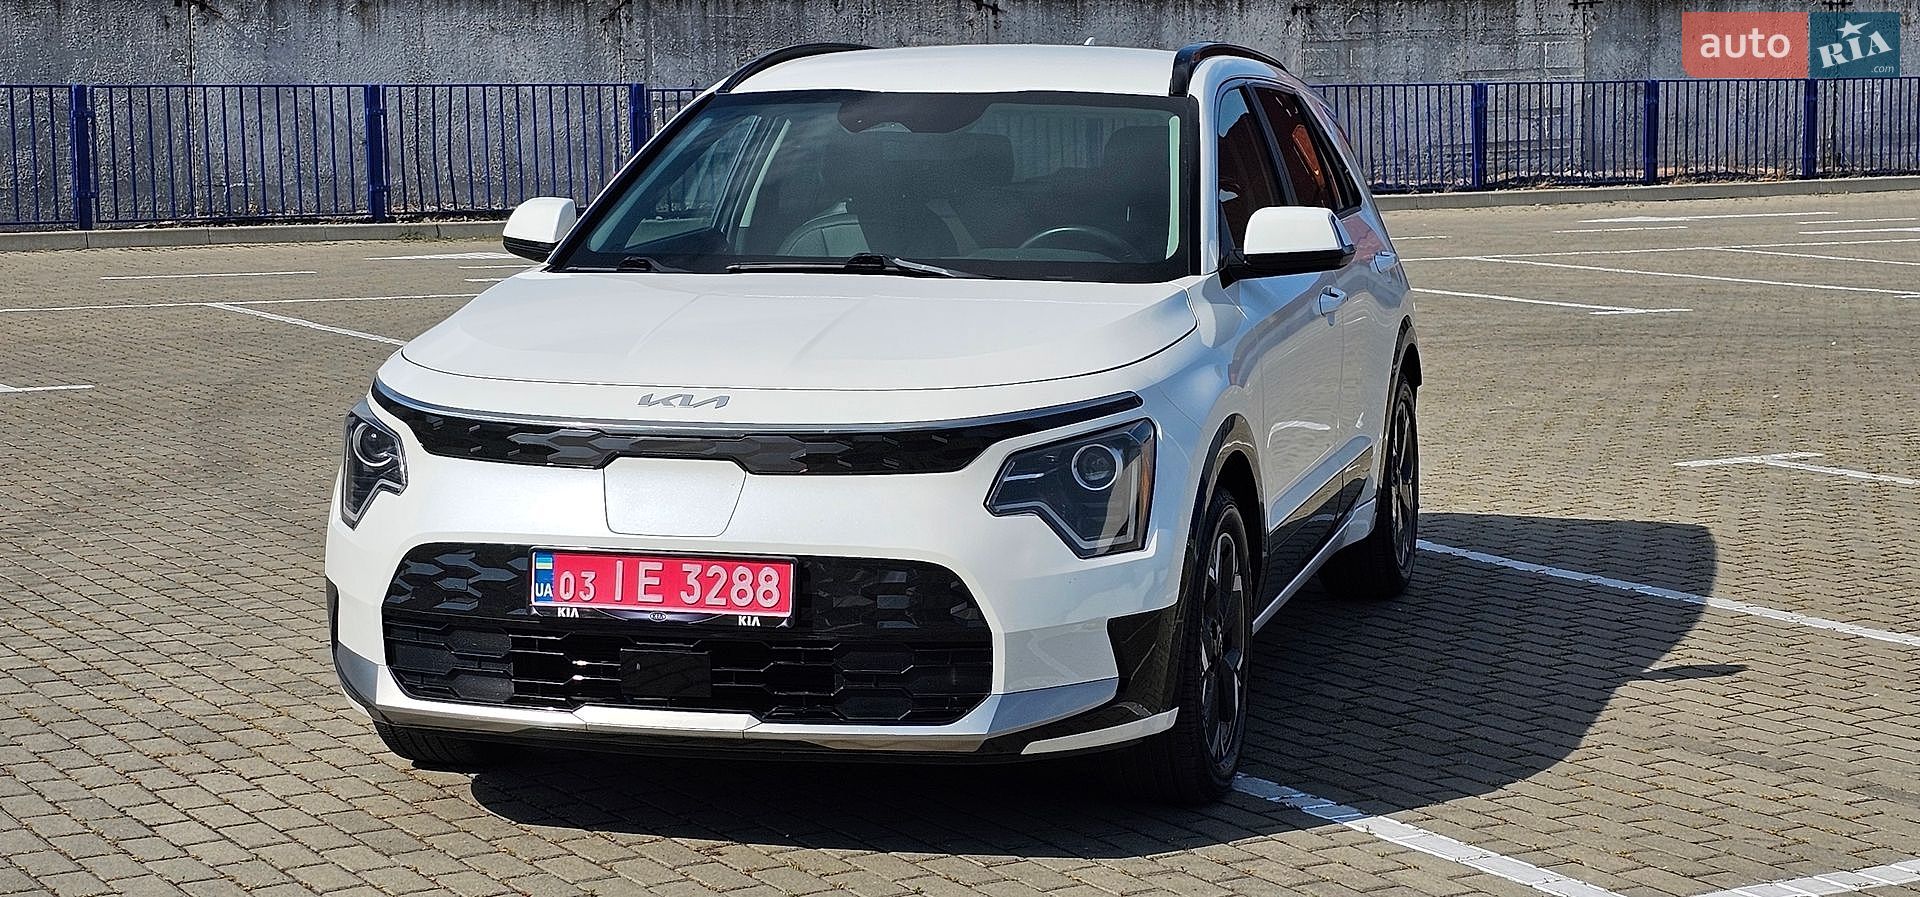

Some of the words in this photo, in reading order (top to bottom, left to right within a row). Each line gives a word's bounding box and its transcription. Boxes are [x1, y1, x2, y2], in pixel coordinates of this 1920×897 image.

[535, 582, 553, 597] UA
[559, 570, 596, 601] 03
[614, 559, 665, 603] IE
[679, 563, 780, 608] 3288
